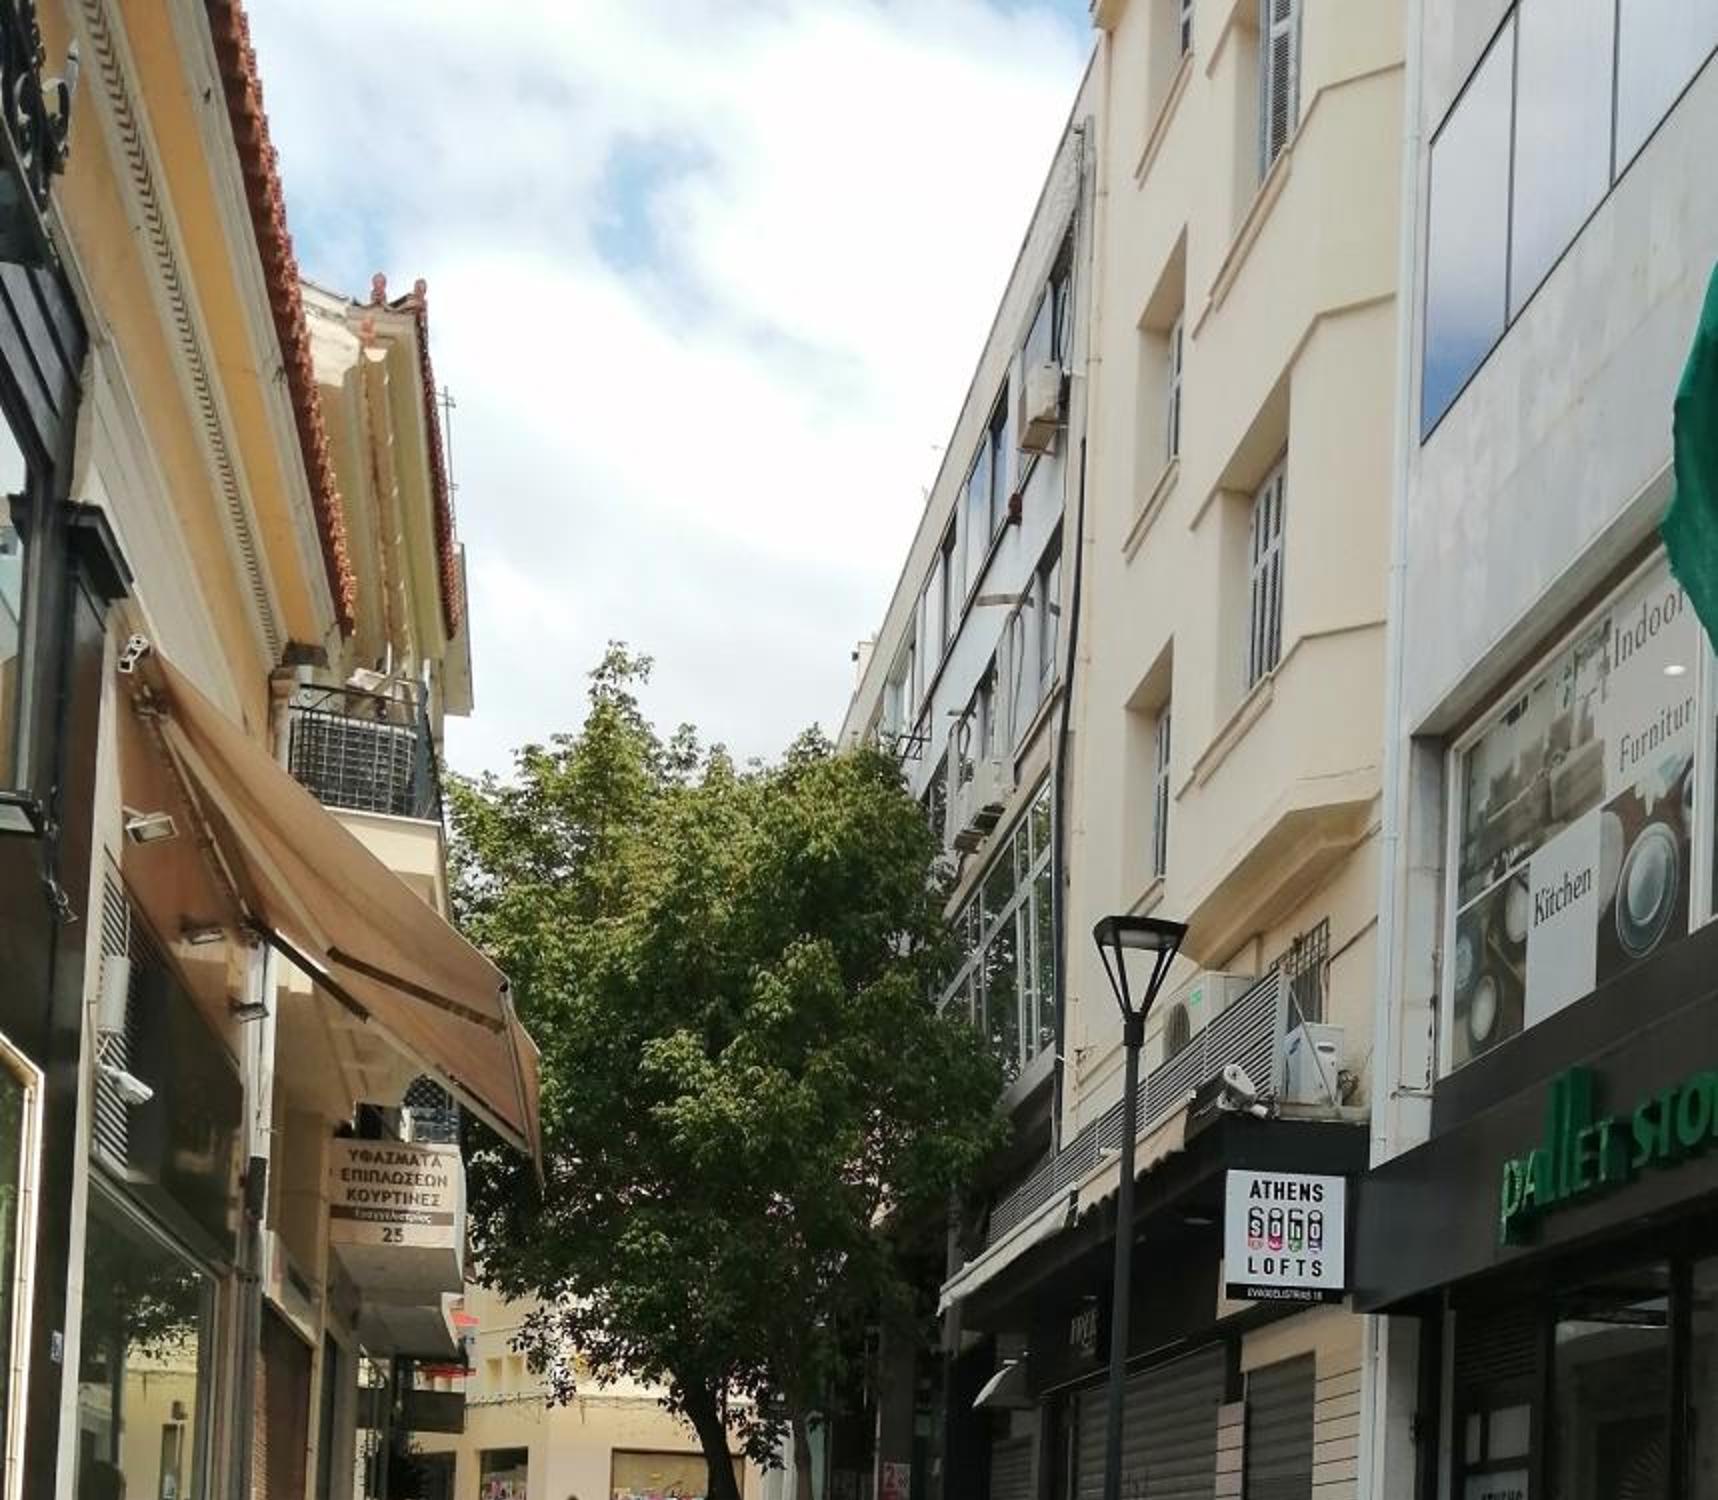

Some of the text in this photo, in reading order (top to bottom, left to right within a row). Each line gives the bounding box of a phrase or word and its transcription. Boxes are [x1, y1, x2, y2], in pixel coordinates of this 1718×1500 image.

[1620, 696, 1696, 773] Furnitur
[1535, 868, 1591, 928] Kitchen
[348, 1149, 442, 1168] ΥΦΑΣΜΑΤΑ
[340, 1168, 448, 1188] ΕΠΙΠΛΩΣΕΩΝ
[346, 1188, 441, 1207] ΚΟΥΡΤΙΝΕΣ
[1249, 1180, 1324, 1202] ATHENS
[382, 1228, 404, 1243] 25
[1247, 1257, 1323, 1277] LOFTS
